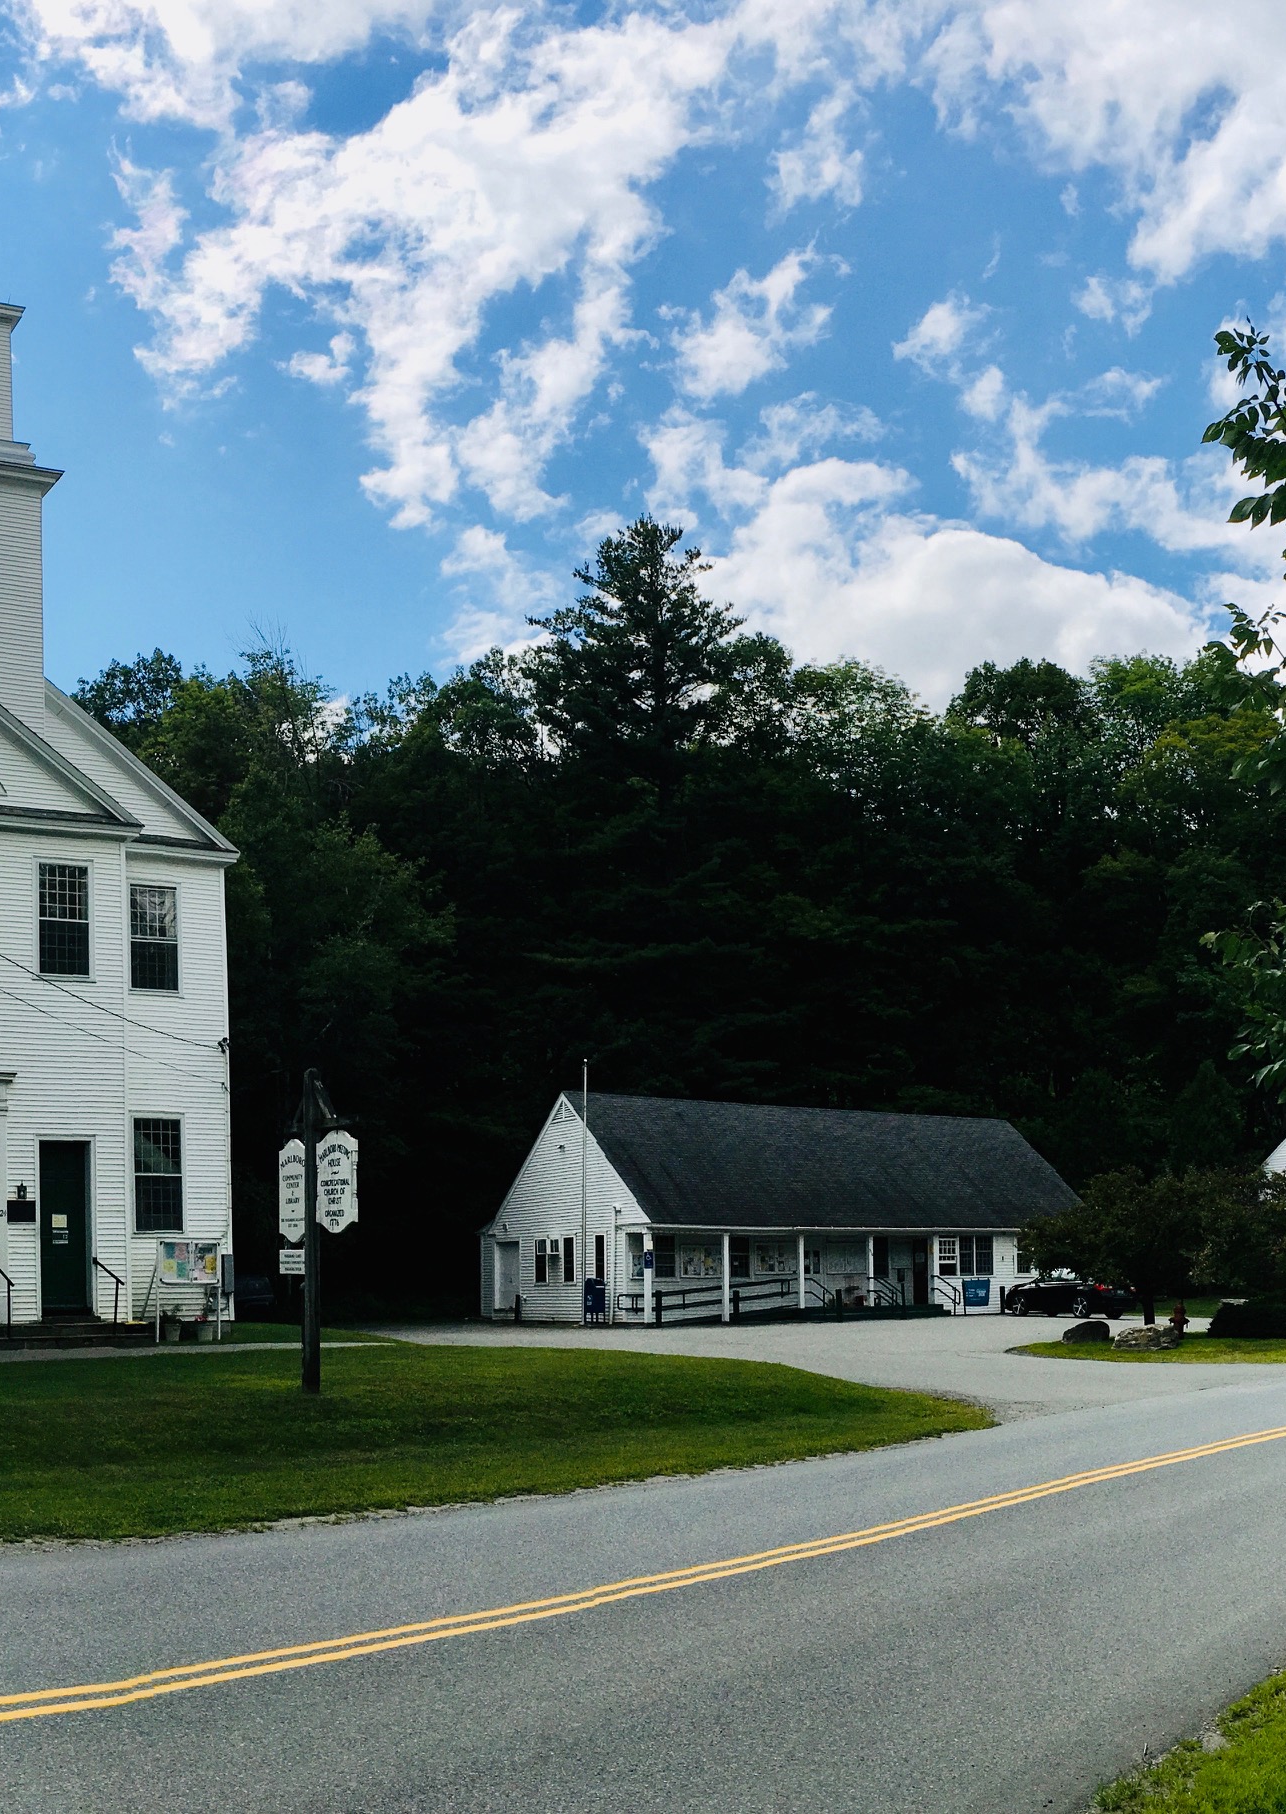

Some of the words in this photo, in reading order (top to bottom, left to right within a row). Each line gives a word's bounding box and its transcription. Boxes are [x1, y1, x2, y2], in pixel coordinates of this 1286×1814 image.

[280, 1154, 305, 1169] MARLBORO
[328, 1158, 341, 1167] HOUSE
[324, 1188, 338, 1196] CHURCH
[325, 1209, 344, 1217] ORGANIZED
